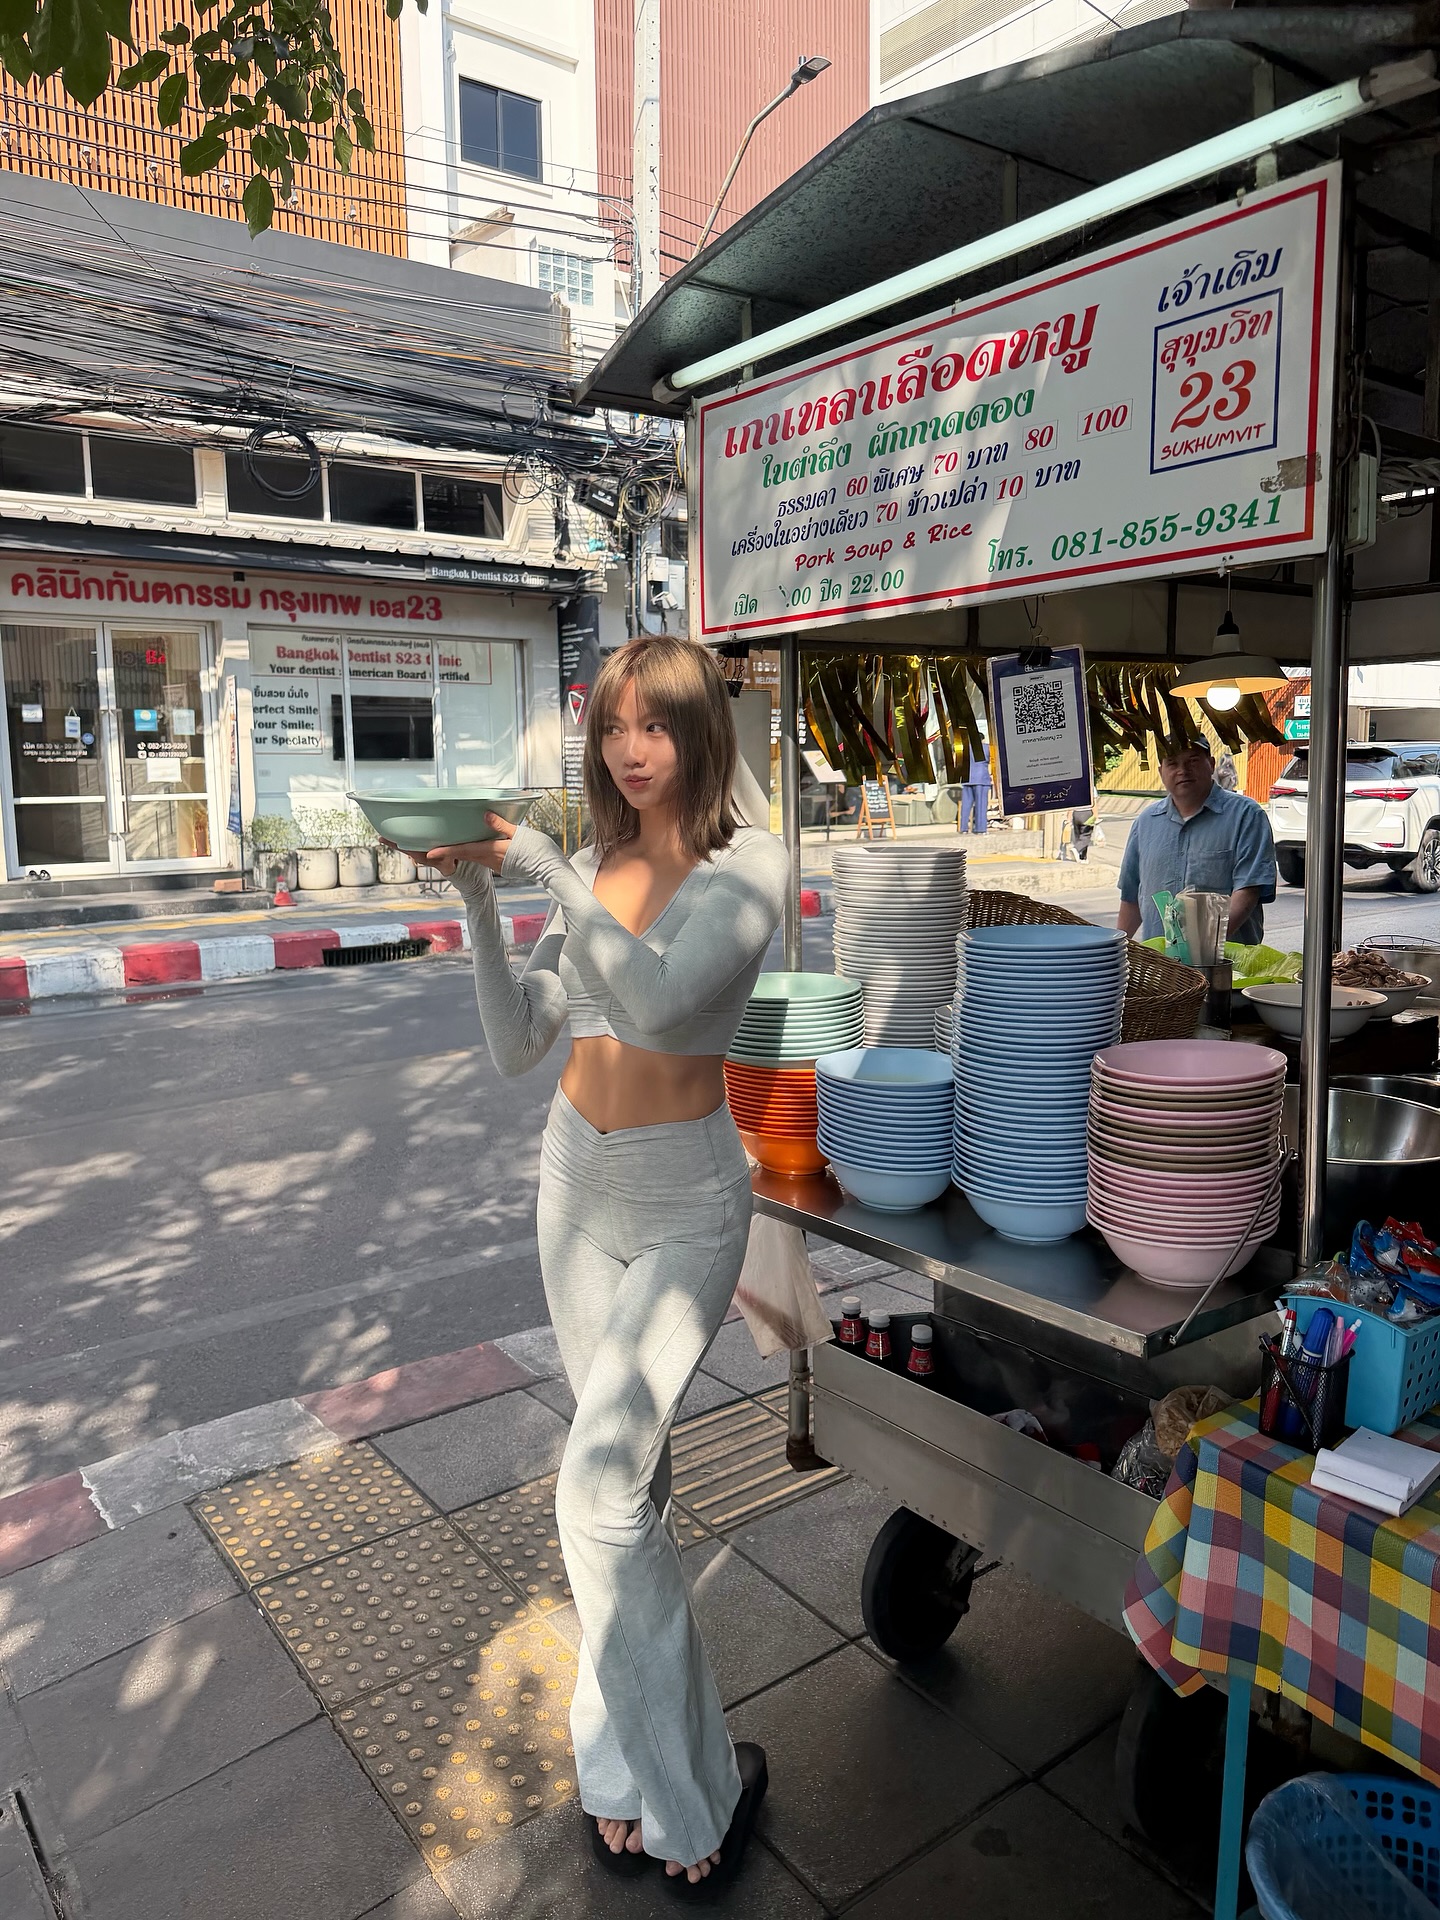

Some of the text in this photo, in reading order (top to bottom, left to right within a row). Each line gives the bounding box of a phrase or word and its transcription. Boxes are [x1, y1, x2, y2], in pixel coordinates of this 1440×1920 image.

[1157, 247, 1283, 312] เจ้าเดิม
[1160, 309, 1273, 374] สุขุมวิท
[724, 304, 1100, 458] เกาเหลาเลือดหมู
[1169, 359, 1256, 433] 23
[762, 388, 1035, 489] ใบตำลึง ผักกาดดอง
[777, 404, 1128, 517] ธรรมดา 60 พิเศษ 70 บาท 80 100
[1160, 423, 1266, 460] SUKHUMVIT
[731, 459, 1081, 557] เครื่องในอย่างเดียว 70 ข้าวเปล่า 10 บาท
[987, 494, 1282, 573] โทร. 081-855-9341
[794, 523, 973, 572] Pork Soup & Rice
[11, 567, 443, 622] คลินิกทันตกรรม กรุงเทพ เอส23
[431, 566, 545, 585] Bangkok Dentist S23 Clinic
[733, 593, 758, 617] เปิด
[820, 578, 842, 602] ปิด
[850, 569, 905, 595] 22.00
[269, 663, 296, 675] Your
[299, 664, 336, 676] dentist
[396, 669, 427, 679] Board
[276, 645, 340, 662] Bangkok
[395, 651, 422, 665] S23
[252, 704, 319, 715] erfect Smile
[255, 735, 321, 747] ur Specialty
